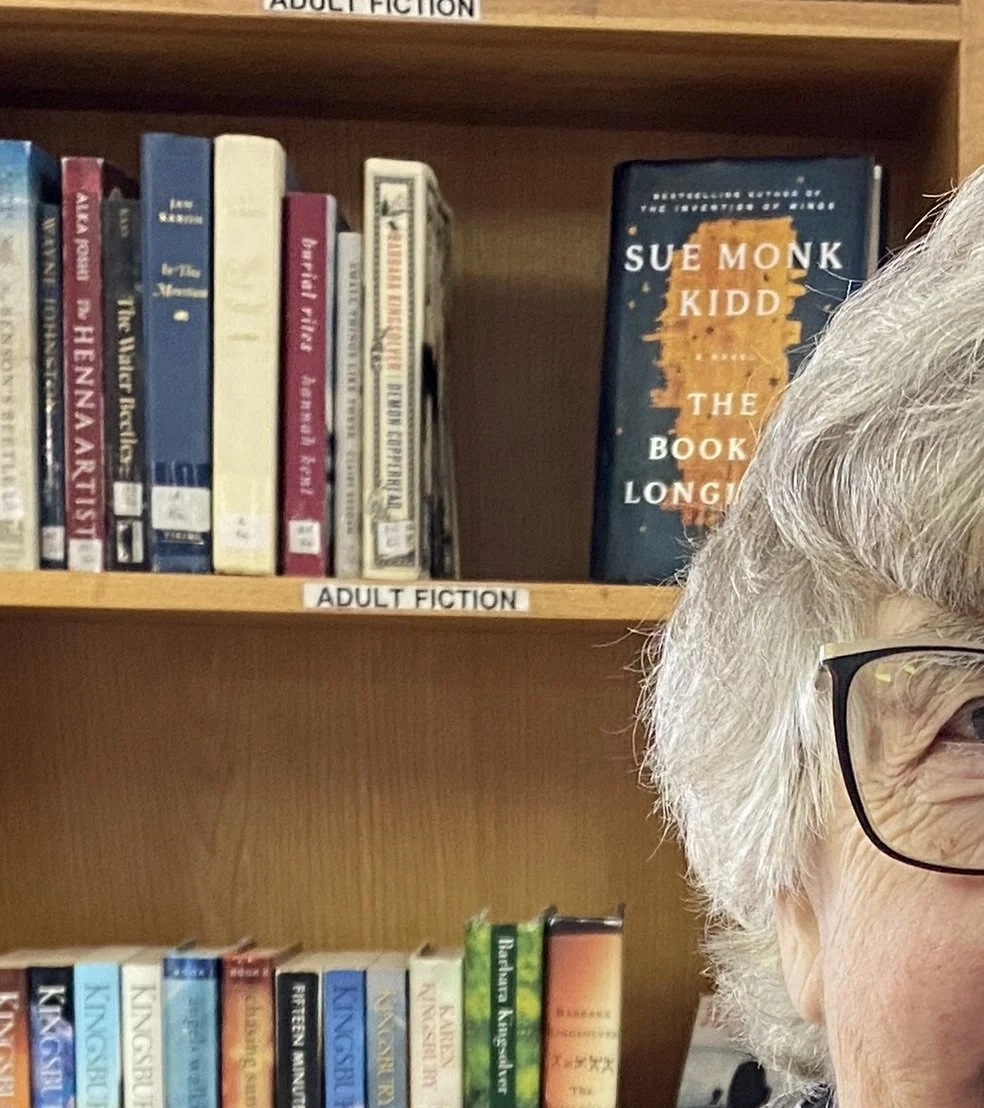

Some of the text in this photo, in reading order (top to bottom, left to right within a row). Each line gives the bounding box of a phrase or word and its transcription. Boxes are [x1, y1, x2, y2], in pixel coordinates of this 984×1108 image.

[370, 0, 475, 17] FICTION
[74, 191, 91, 282] ALKA JOSHI
[639, 204, 667, 214] THE
[623, 241, 844, 273] SUE MONK
[299, 237, 319, 353] burial rites
[679, 288, 781, 318] KIDD
[73, 325, 96, 430] HENNA
[116, 295, 139, 465] The Water Beetles
[299, 373, 317, 447] hannah
[386, 382, 403, 426] DEMON
[687, 391, 759, 416] THE
[386, 430, 403, 510] COPPERHEAD
[647, 436, 748, 461] BOOK
[72, 437, 98, 539] ARTIST
[622, 480, 738, 505] LONGI
[316, 586, 517, 610] ADULT FICTION
[242, 994, 263, 1068] chasing
[291, 983, 307, 1047] FIFTEEN
[375, 988, 397, 1107] KINGSBURY
[416, 983, 438, 1090] KINGSBURY
[438, 1003, 456, 1070] KAREN
[491, 936, 514, 1096] Barbara Kingsolver
